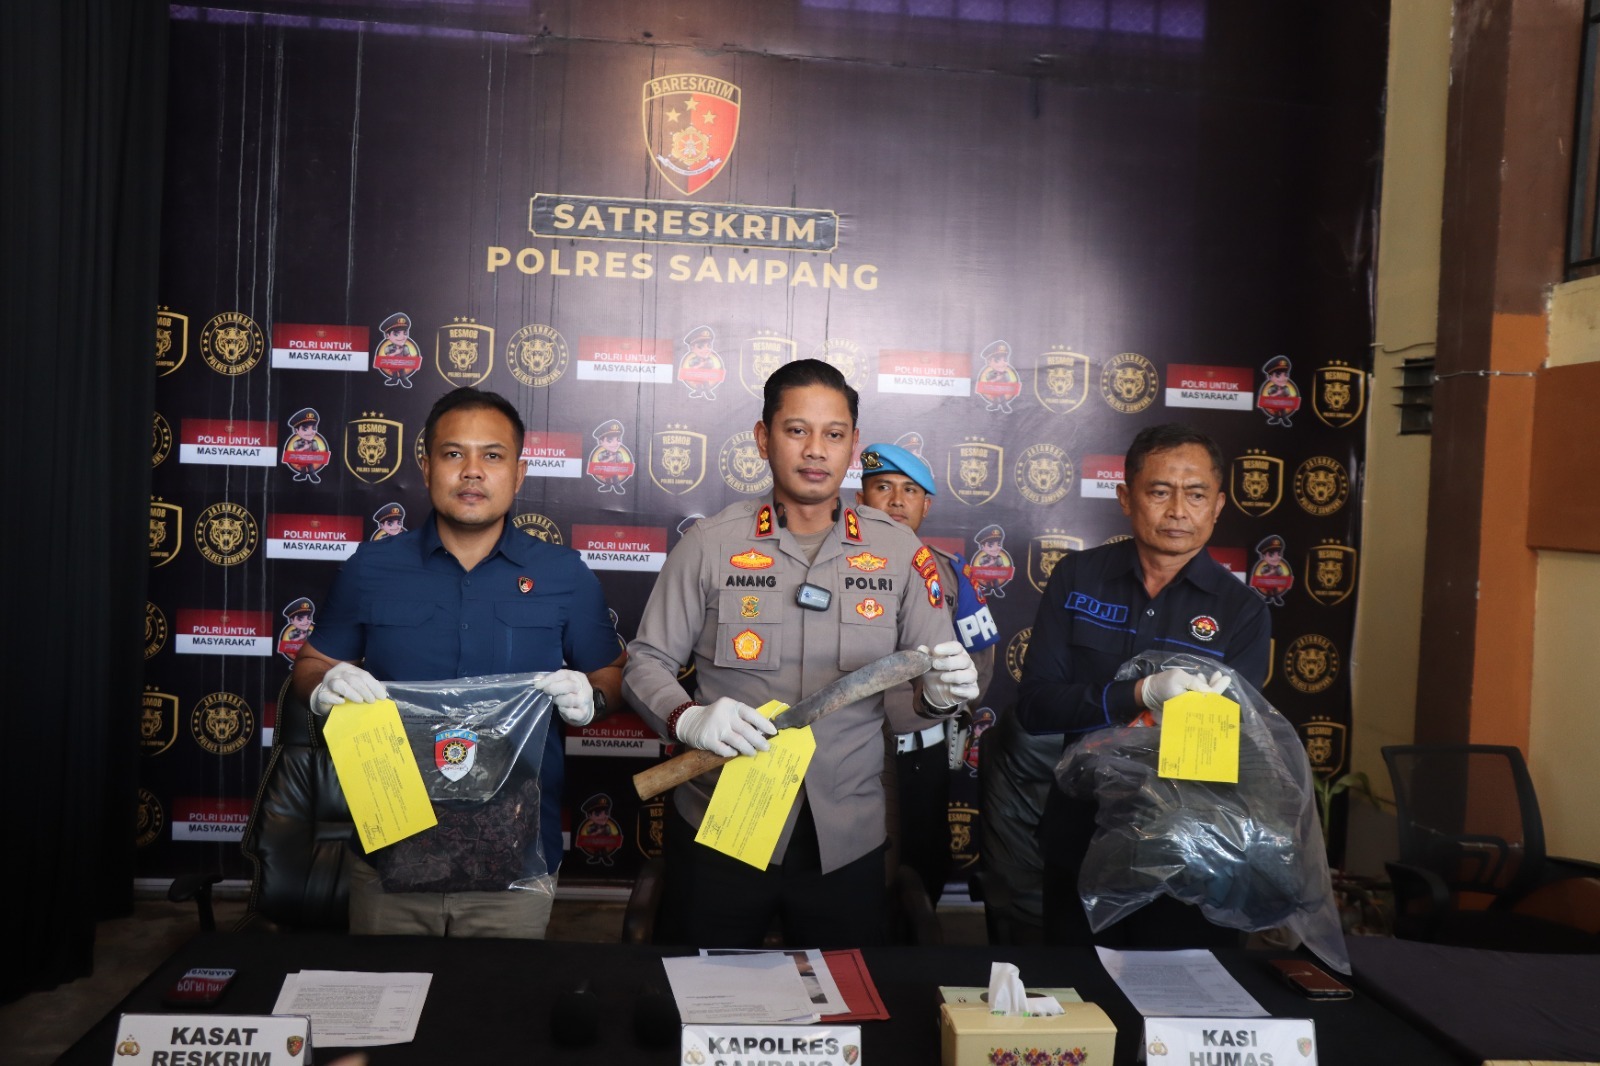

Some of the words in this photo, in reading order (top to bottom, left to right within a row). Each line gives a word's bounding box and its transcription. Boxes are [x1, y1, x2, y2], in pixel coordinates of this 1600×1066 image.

[651, 77, 734, 99] BARESKRIM
[553, 204, 816, 242] SATRESKRIM
[486, 246, 654, 280] POLRES
[670, 255, 878, 290] SAMPANG
[214, 314, 253, 327] JATANRAS
[450, 329, 478, 339] RESMOB
[520, 326, 557, 340] JATANRAS
[289, 340, 318, 348] POLRI
[320, 341, 352, 350] UNTUK
[289, 352, 352, 362] MASYARAKAT
[594, 352, 622, 360] POLRI
[625, 354, 656, 362] UNTUK
[594, 364, 656, 374] MASYARAKAT
[894, 366, 922, 374] POLRI
[925, 368, 956, 376] UNTUK
[894, 377, 956, 387] MASYARAKAT
[1181, 380, 1208, 389] POLRI
[1209, 382, 1238, 390] UNTUK
[1181, 391, 1238, 401] MASYARAKAT
[358, 424, 386, 434] RESMOB
[198, 436, 226, 444] POLRI
[228, 437, 260, 446] UNTUK
[662, 436, 692, 446] RESMOB
[197, 447, 261, 456] MASYARAKAT
[534, 448, 566, 456] UNTUK
[960, 448, 988, 458] RESMOB
[1096, 470, 1124, 479] POLRI
[208, 504, 246, 518] JATANRAS
[284, 530, 312, 538] POLRI
[314, 532, 346, 540] UNTUK
[284, 542, 347, 552] MASYARAKAT
[588, 541, 616, 550] POLRI
[618, 542, 650, 550] UNTUK
[202, 546, 222, 564] POLRES
[224, 548, 250, 564] SAMPANG
[588, 553, 650, 562] MASYARAKAT
[726, 575, 776, 588] ANANG
[844, 577, 893, 591] POLRI
[1075, 596, 1118, 620] PUJI
[193, 626, 222, 634] POLRI
[224, 627, 256, 636] UNTUK
[192, 637, 256, 646] MASYARAKAT
[204, 694, 242, 706] JATANRAS
[582, 728, 610, 736] POLRI
[582, 739, 644, 748] MASYARAKAT
[189, 812, 218, 821] POLRI
[170, 1027, 258, 1046] KASAT
[1202, 1030, 1258, 1048] KASI
[708, 1037, 839, 1056] KAPOLRES
[152, 1051, 272, 1066] RESKRIM
[1189, 1052, 1274, 1066] HUMAS
